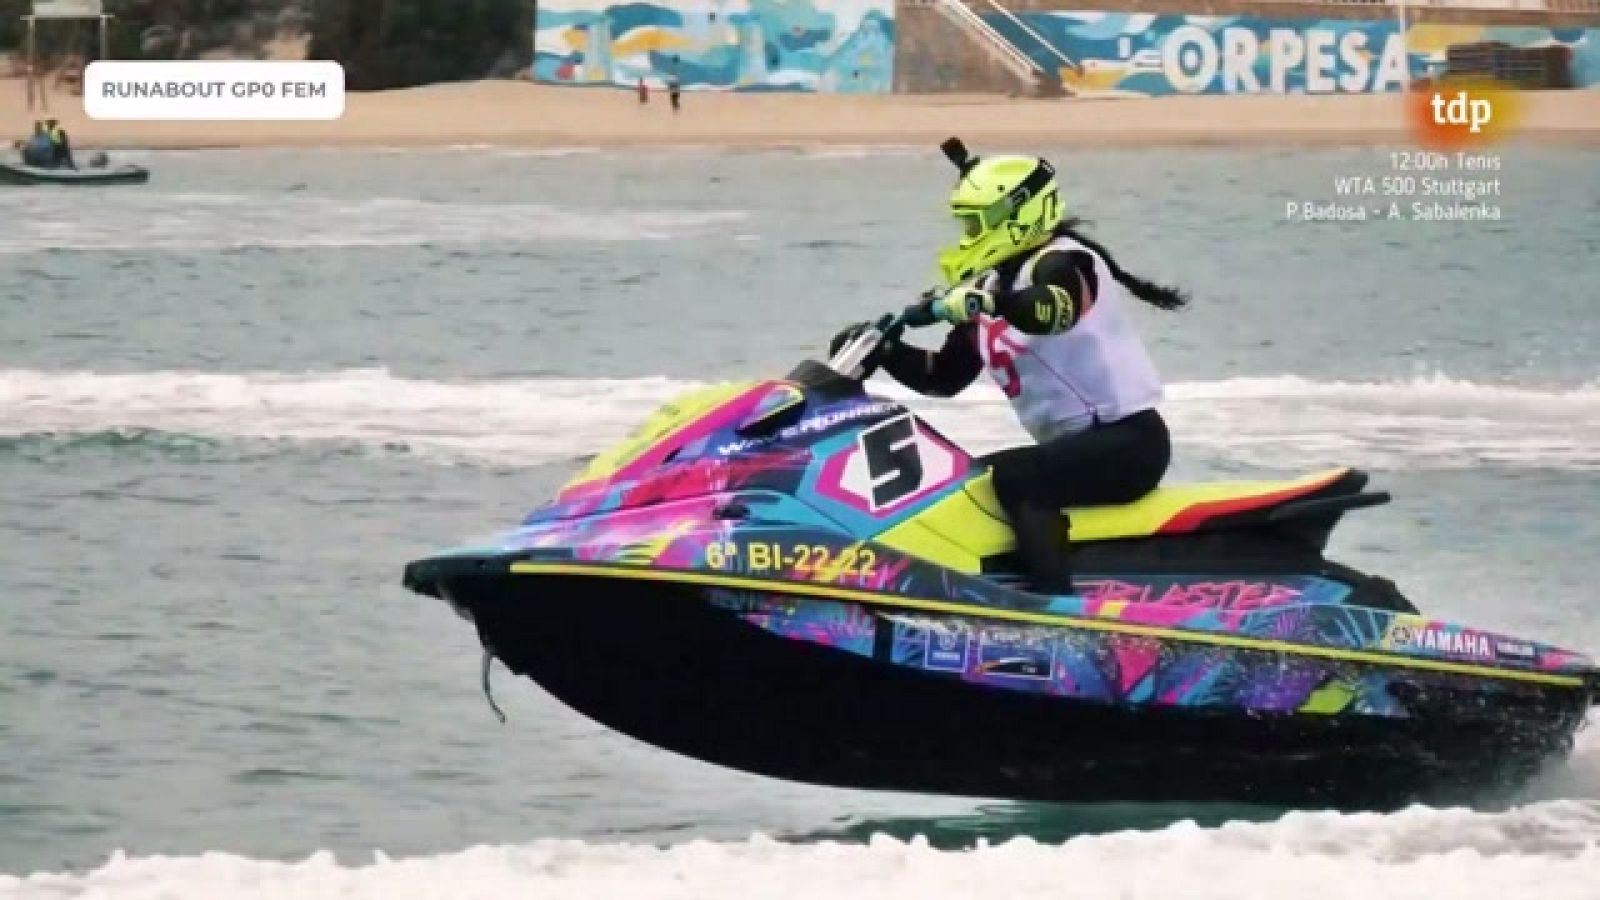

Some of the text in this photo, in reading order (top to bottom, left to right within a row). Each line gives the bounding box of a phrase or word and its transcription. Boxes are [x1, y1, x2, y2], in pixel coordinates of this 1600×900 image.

[1161, 25, 1407, 94] ORPESA
[860, 412, 925, 511] 5
[1412, 628, 1491, 657] YAMAHA
